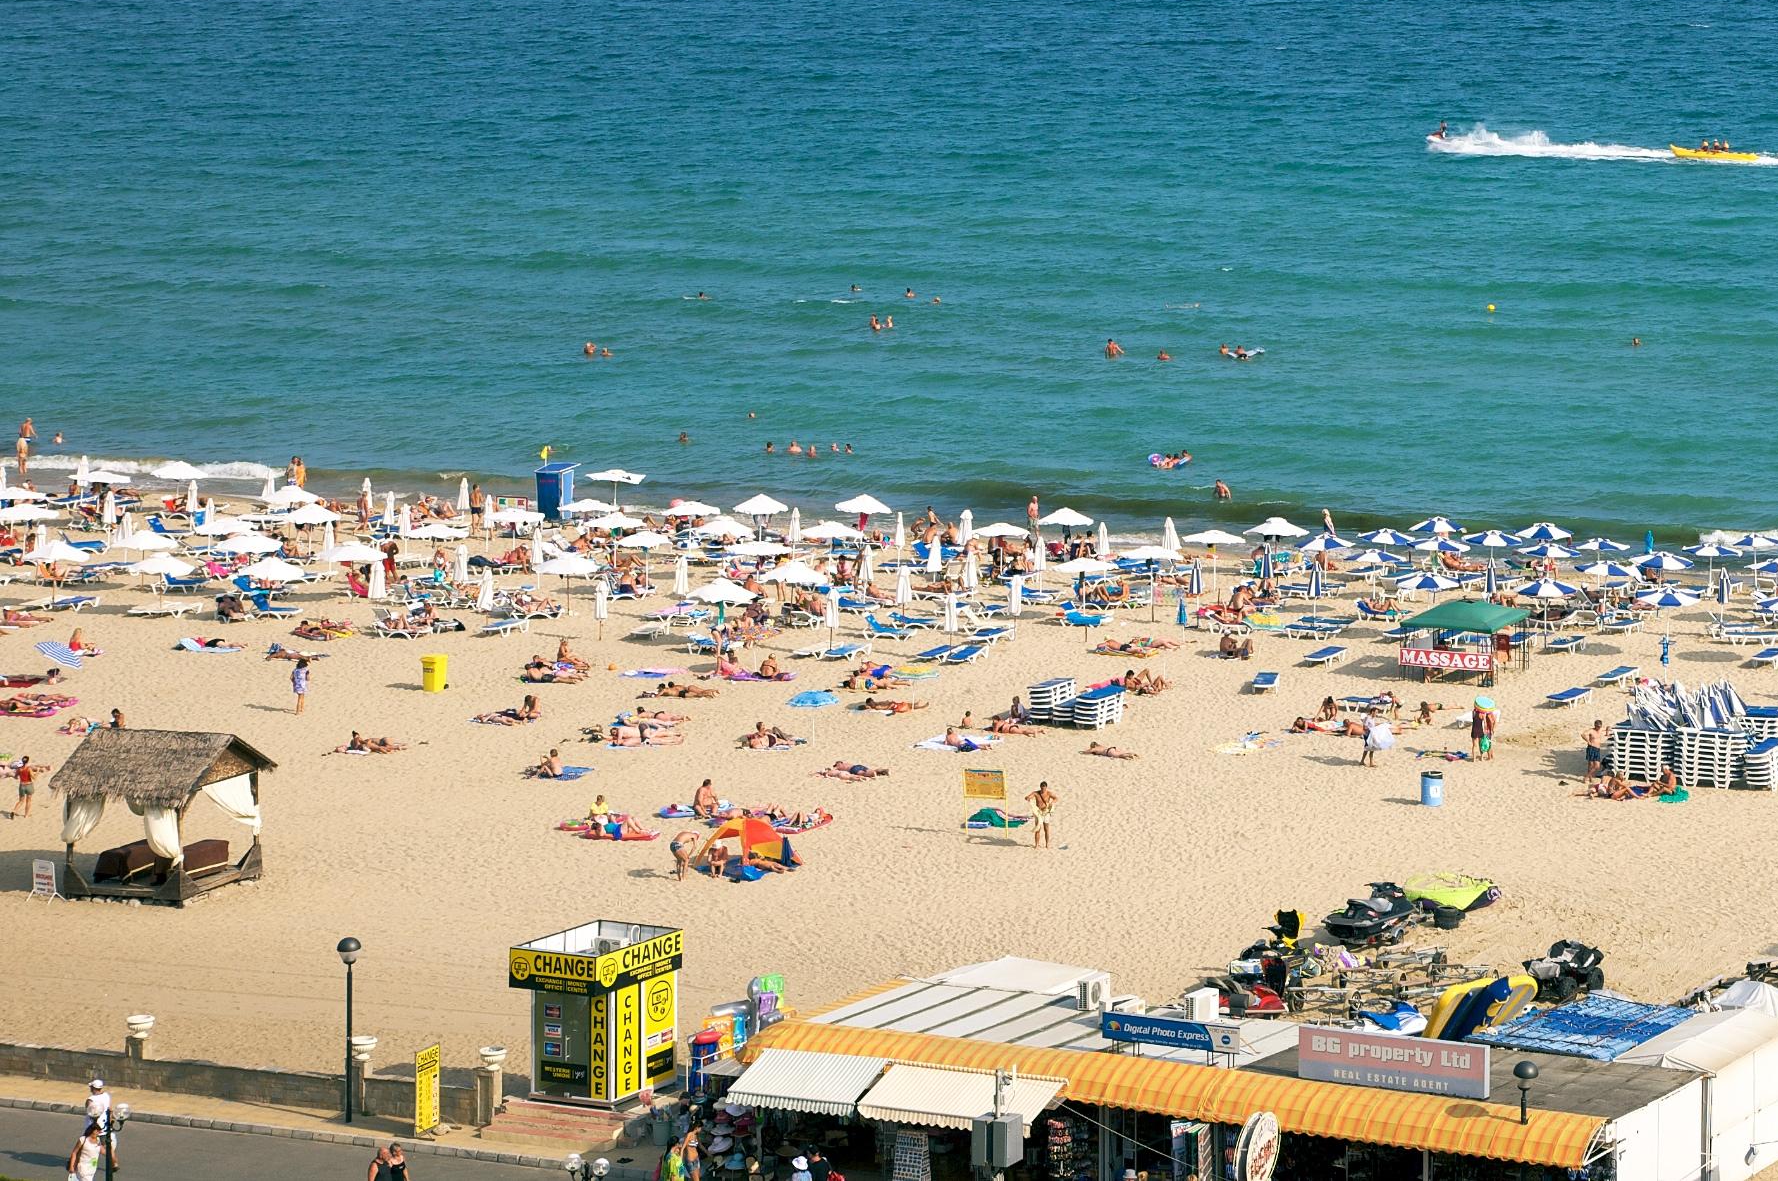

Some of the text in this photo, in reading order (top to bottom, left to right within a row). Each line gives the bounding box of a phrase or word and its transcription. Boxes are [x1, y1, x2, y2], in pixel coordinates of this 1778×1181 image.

[1401, 650, 1490, 669] MASSAGE
[622, 933, 681, 969] CHANGE
[533, 954, 593, 979] CHANGE
[535, 977, 563, 985] EXCHANGE
[544, 984, 563, 992] OFFICE
[567, 980, 587, 988] MONEY
[567, 986, 588, 994] CENTER
[1123, 1023, 1210, 1042] Digital Photo Express
[592, 999, 605, 1096] CHANGE
[622, 995, 633, 1091] CHANGE
[1311, 1035, 1471, 1069] BG property Ltd
[417, 1047, 439, 1065] CHANGE
[544, 1066, 571, 1074] WESTERN
[552, 1071, 571, 1079] UNION
[1333, 1069, 1449, 1091] REAL ESTATE AGENT
